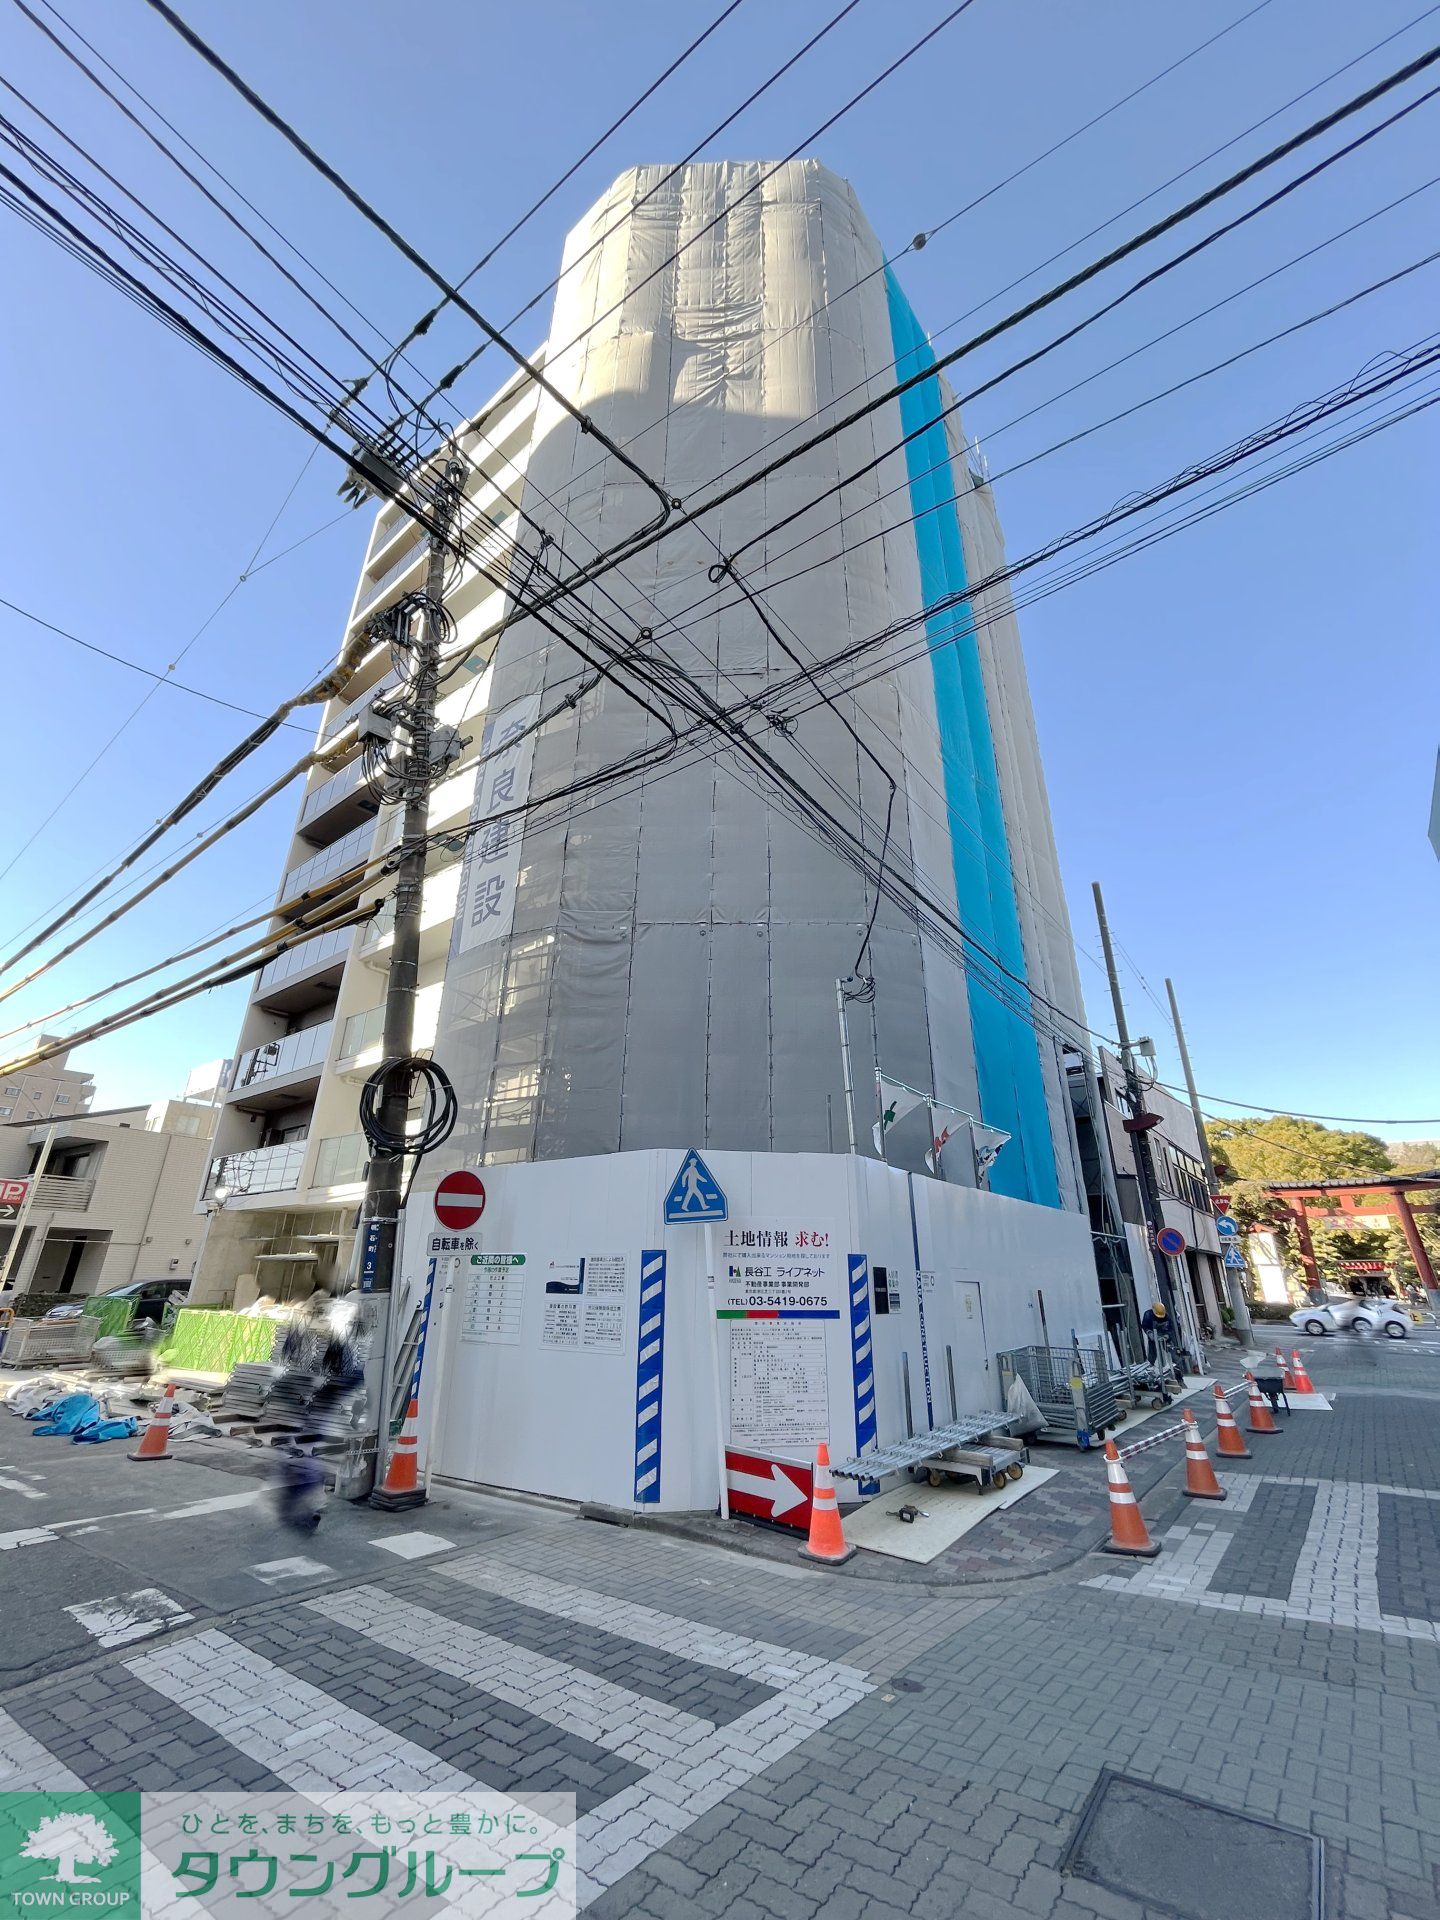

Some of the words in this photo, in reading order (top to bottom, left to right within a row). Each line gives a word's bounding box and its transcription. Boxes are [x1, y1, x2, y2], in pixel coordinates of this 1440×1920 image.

[432, 1238, 479, 1251] 自転車を除く
[723, 1230, 788, 1248] 土地情報
[795, 1231, 829, 1248] 求む!
[745, 1266, 772, 1277] 長谷工
[749, 1296, 828, 1307] 03-5419-0675
